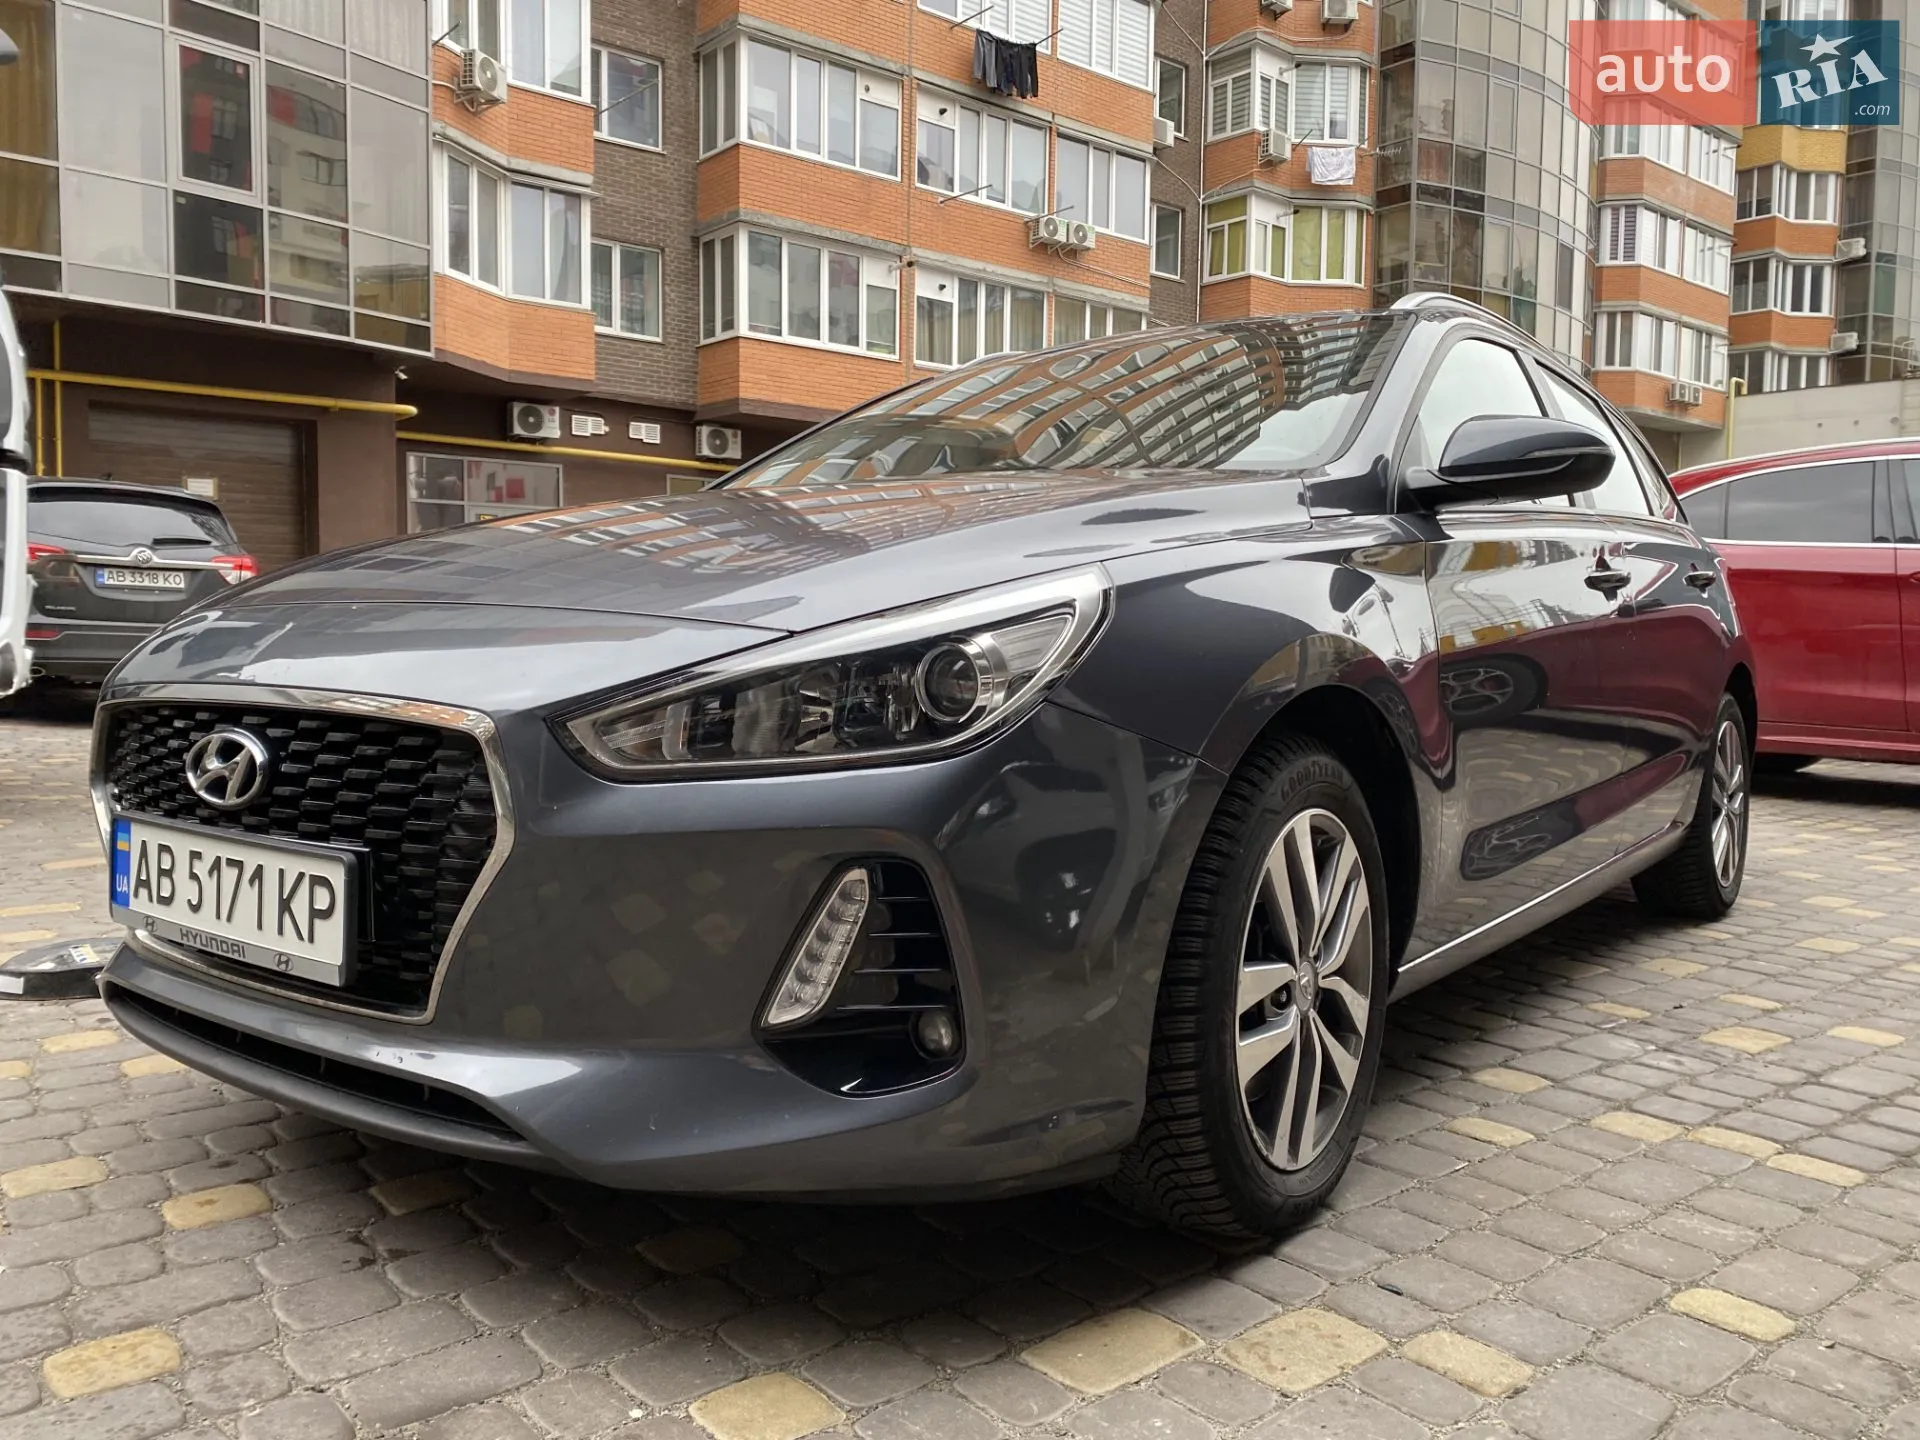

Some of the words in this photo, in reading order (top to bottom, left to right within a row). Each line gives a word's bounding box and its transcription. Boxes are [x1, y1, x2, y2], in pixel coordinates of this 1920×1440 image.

[106, 571, 126, 582] AB
[129, 571, 159, 584] 3318
[163, 573, 182, 586] KO
[115, 873, 129, 894] UA
[133, 839, 176, 906] AB
[187, 850, 264, 931] 5171
[277, 867, 336, 944] KP
[180, 928, 246, 959] HYUNDAI
